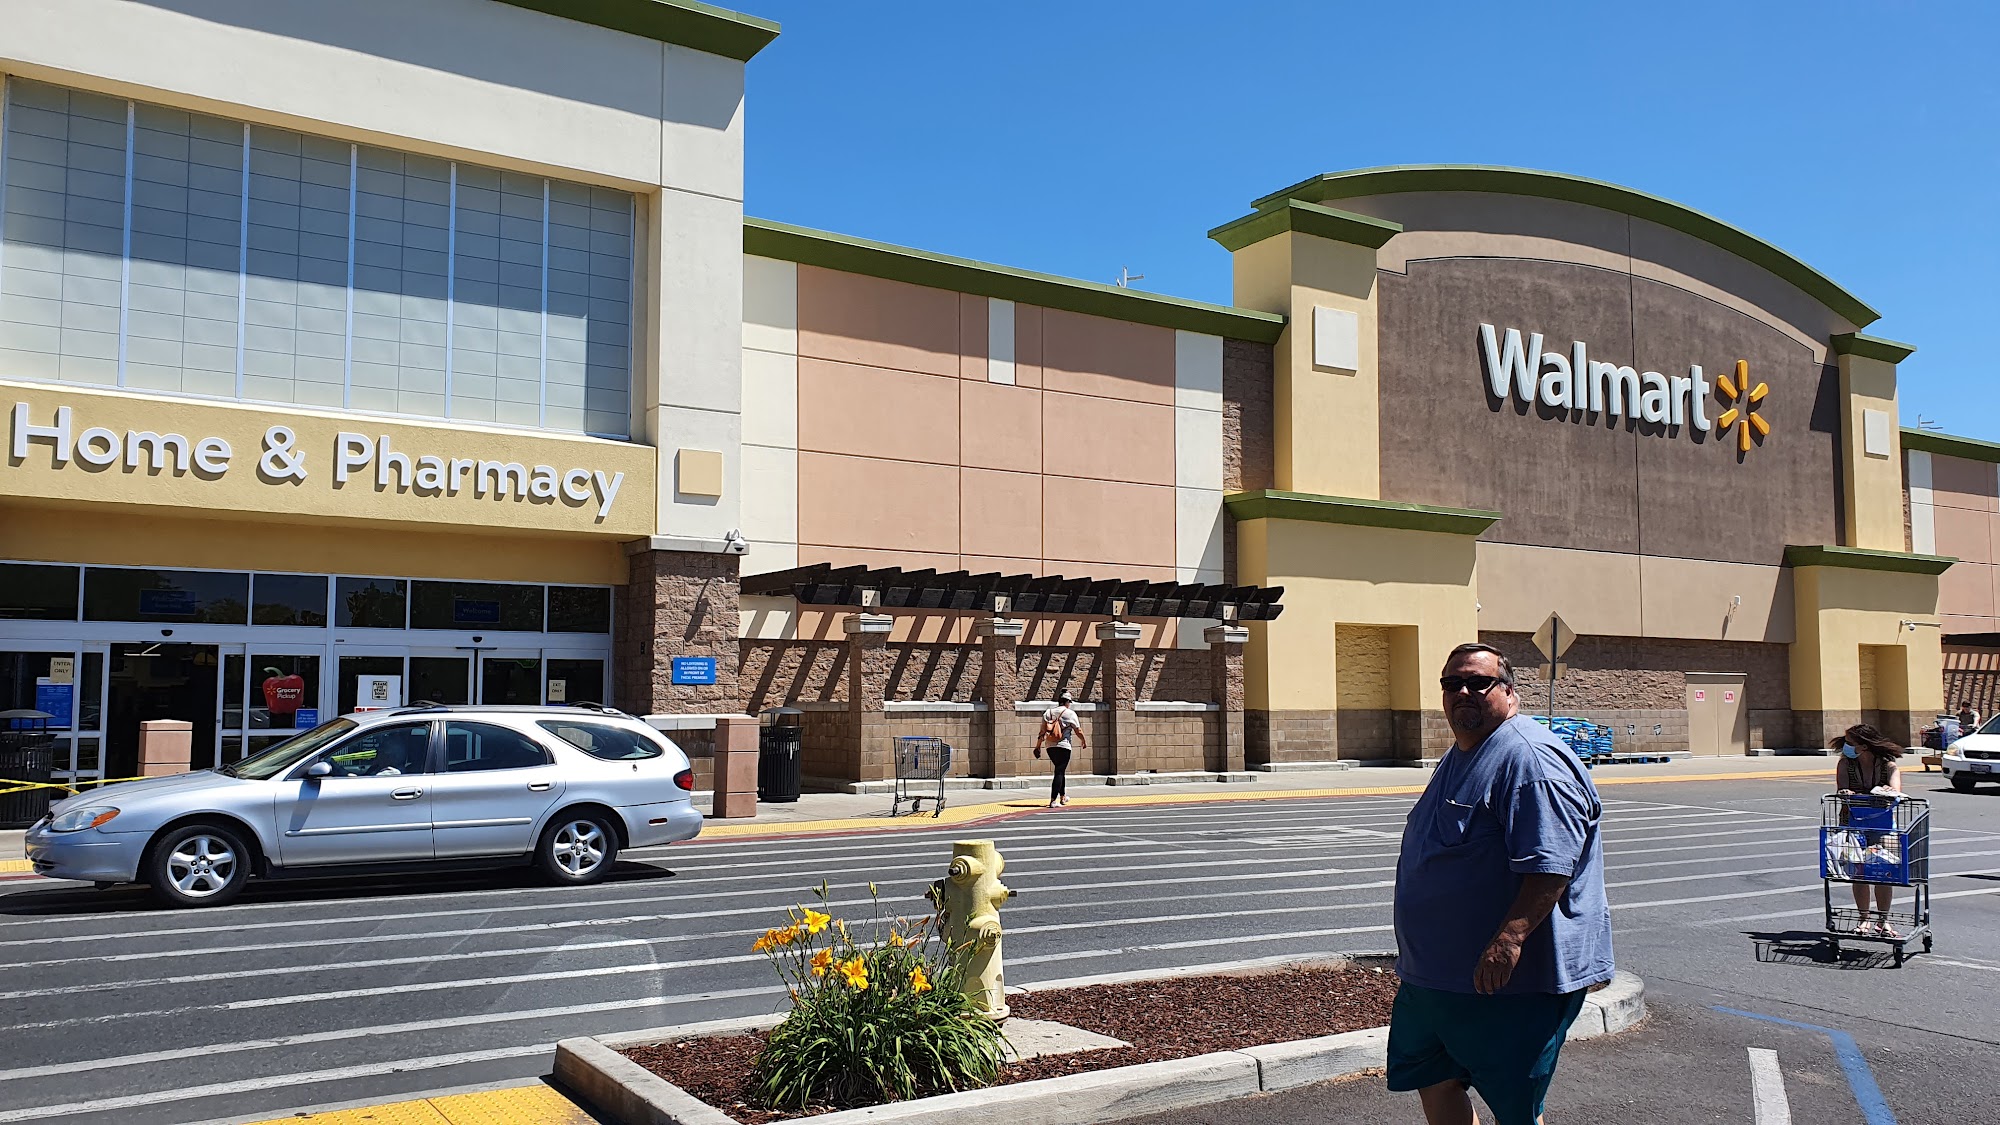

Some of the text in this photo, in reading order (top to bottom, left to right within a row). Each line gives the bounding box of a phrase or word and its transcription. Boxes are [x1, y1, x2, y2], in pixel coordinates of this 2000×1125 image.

[1479, 322, 1711, 432] Walmart
[10, 402, 625, 517] Home & Pharmacy
